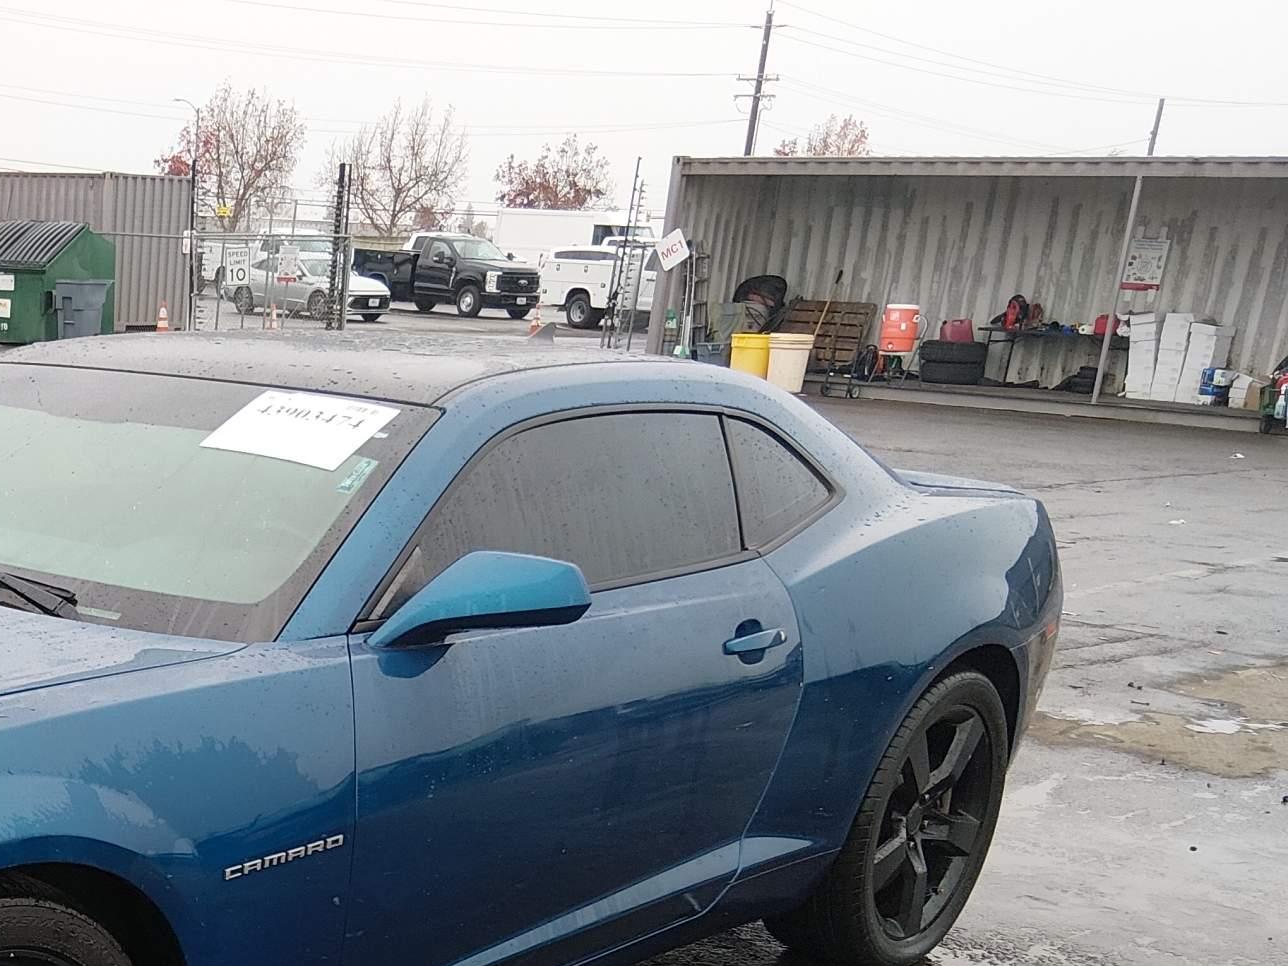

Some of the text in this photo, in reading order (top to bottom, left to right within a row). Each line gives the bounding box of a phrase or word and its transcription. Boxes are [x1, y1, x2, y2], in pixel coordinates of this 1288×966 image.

[228, 250, 248, 258] SPEED
[661, 240, 684, 261] MC1
[230, 267, 246, 282] 10
[224, 833, 344, 881] CAMARO
